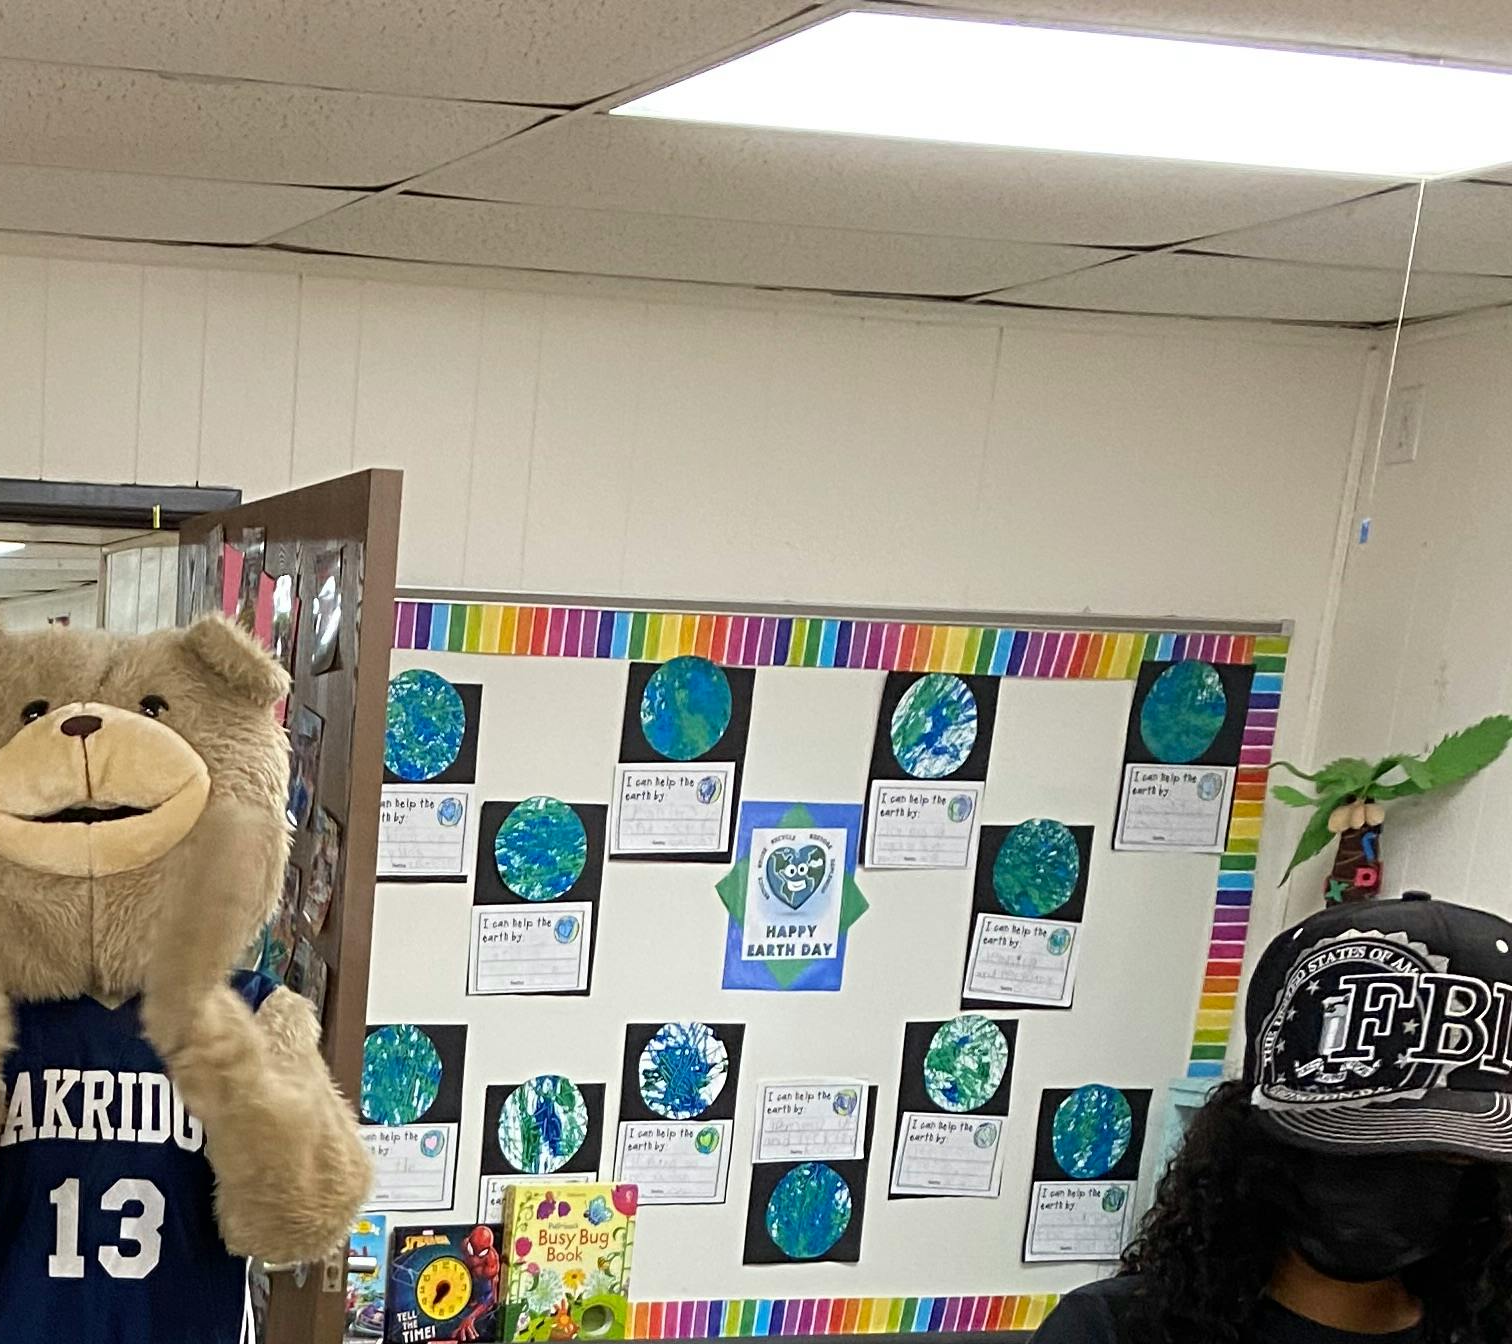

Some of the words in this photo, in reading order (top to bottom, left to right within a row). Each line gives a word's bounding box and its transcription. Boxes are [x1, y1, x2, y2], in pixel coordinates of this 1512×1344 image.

[626, 777, 632, 788] I
[636, 778, 654, 788] can
[655, 777, 677, 790] help
[679, 776, 695, 788] the
[625, 791, 652, 801] earth
[881, 793, 887, 805] I
[889, 795, 907, 805] can
[909, 794, 930, 806] help
[932, 795, 947, 806] the
[880, 807, 905, 818] earth
[483, 919, 488, 929] I
[492, 920, 509, 929] can
[512, 919, 534, 931] help
[537, 918, 551, 928] the
[482, 932, 509, 943] earth
[766, 925, 818, 939] HAPPY
[747, 943, 796, 958] EARTH
[801, 943, 833, 957] DAY
[1369, 948, 1392, 963] OF
[768, 1091, 774, 1101] I
[775, 1092, 792, 1101] can
[796, 1091, 815, 1103] help
[818, 1090, 832, 1101] the
[767, 1105, 792, 1114] earth
[629, 1128, 635, 1138] I
[637, 1128, 654, 1138] can
[656, 1128, 677, 1140] help
[680, 1128, 694, 1138] the
[627, 1143, 653, 1152] earth
[49, 1178, 166, 1280] 13
[539, 1229, 577, 1248] Busy
[579, 1229, 610, 1249] Bug
[546, 1247, 583, 1263] Book
[397, 1311, 418, 1324] TELL
[402, 1320, 419, 1331] THE
